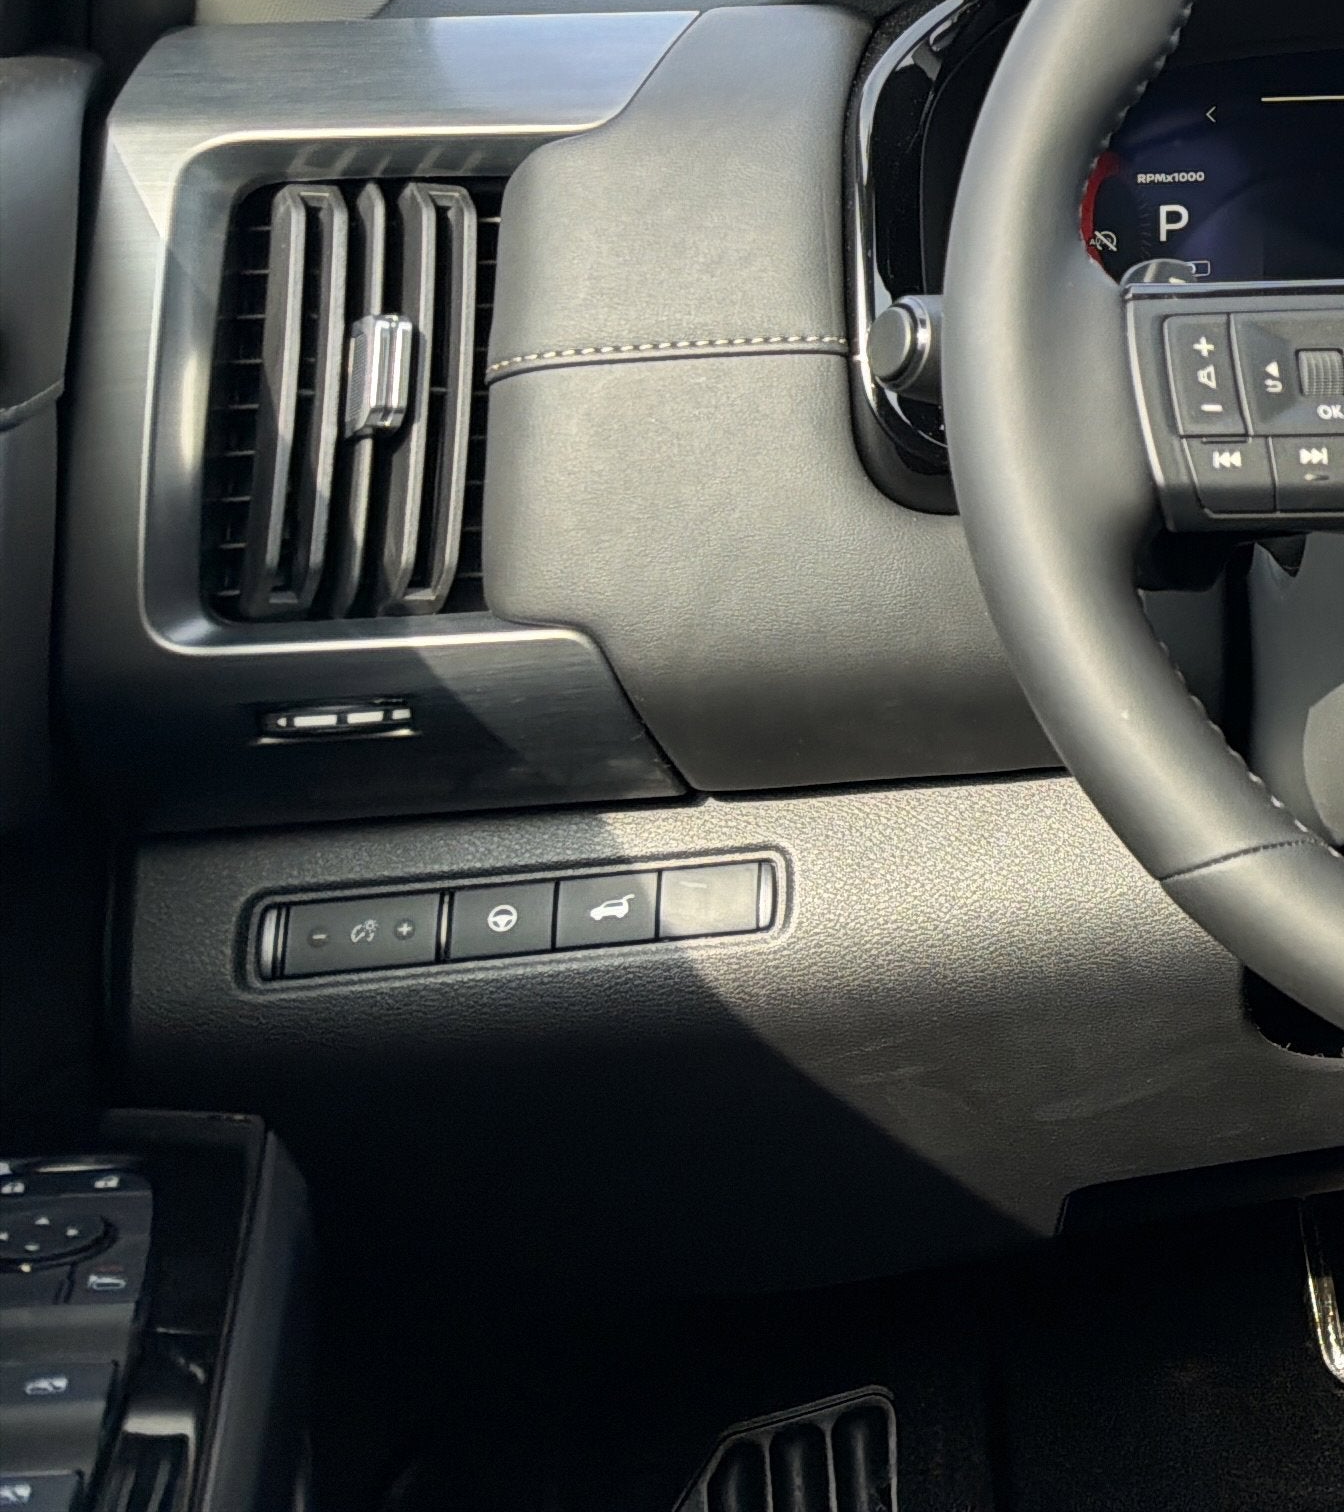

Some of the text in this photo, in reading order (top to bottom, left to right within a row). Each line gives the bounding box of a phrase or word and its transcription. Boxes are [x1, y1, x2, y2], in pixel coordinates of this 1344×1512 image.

[1137, 172, 1205, 183] RPMx1000
[1160, 204, 1189, 242] P
[1317, 404, 1344, 420] OK
